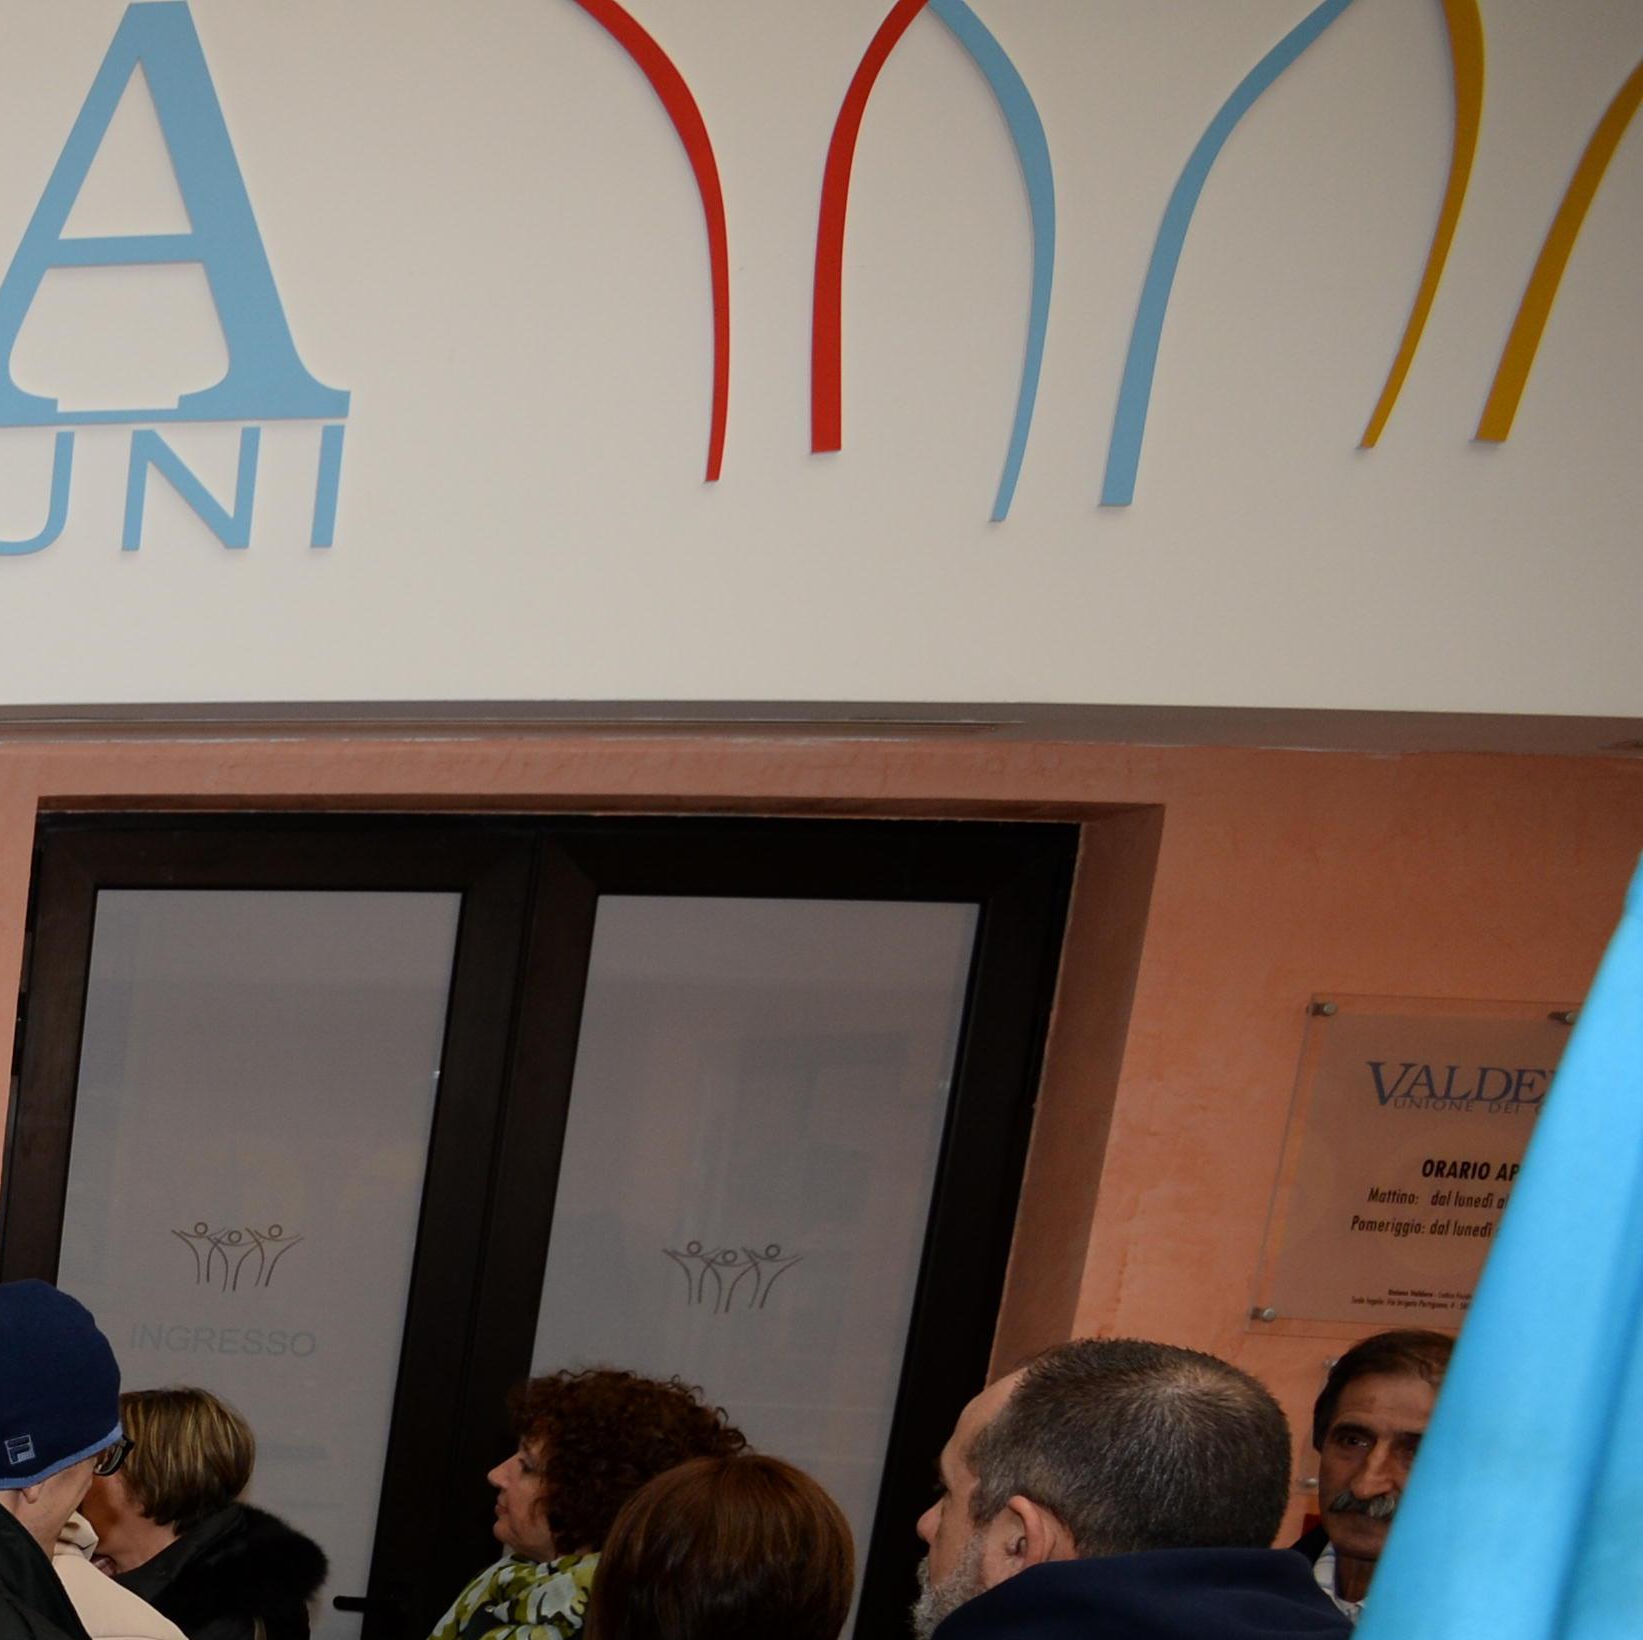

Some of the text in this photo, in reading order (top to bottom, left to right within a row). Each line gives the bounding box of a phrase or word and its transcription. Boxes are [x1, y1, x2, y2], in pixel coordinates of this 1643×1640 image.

[1367, 1061, 1558, 1106] VALDE
[1394, 1098, 1473, 1113] UNIONE
[1488, 1102, 1520, 1114] DEI
[1422, 1159, 1520, 1182] ORARIO AP
[1368, 1187, 1419, 1205] Mattino:
[1430, 1190, 1451, 1207] dal
[1351, 1215, 1426, 1237] Pomeriggio:
[1429, 1219, 1451, 1236] dal
[130, 1322, 316, 1358] INGRESSO
